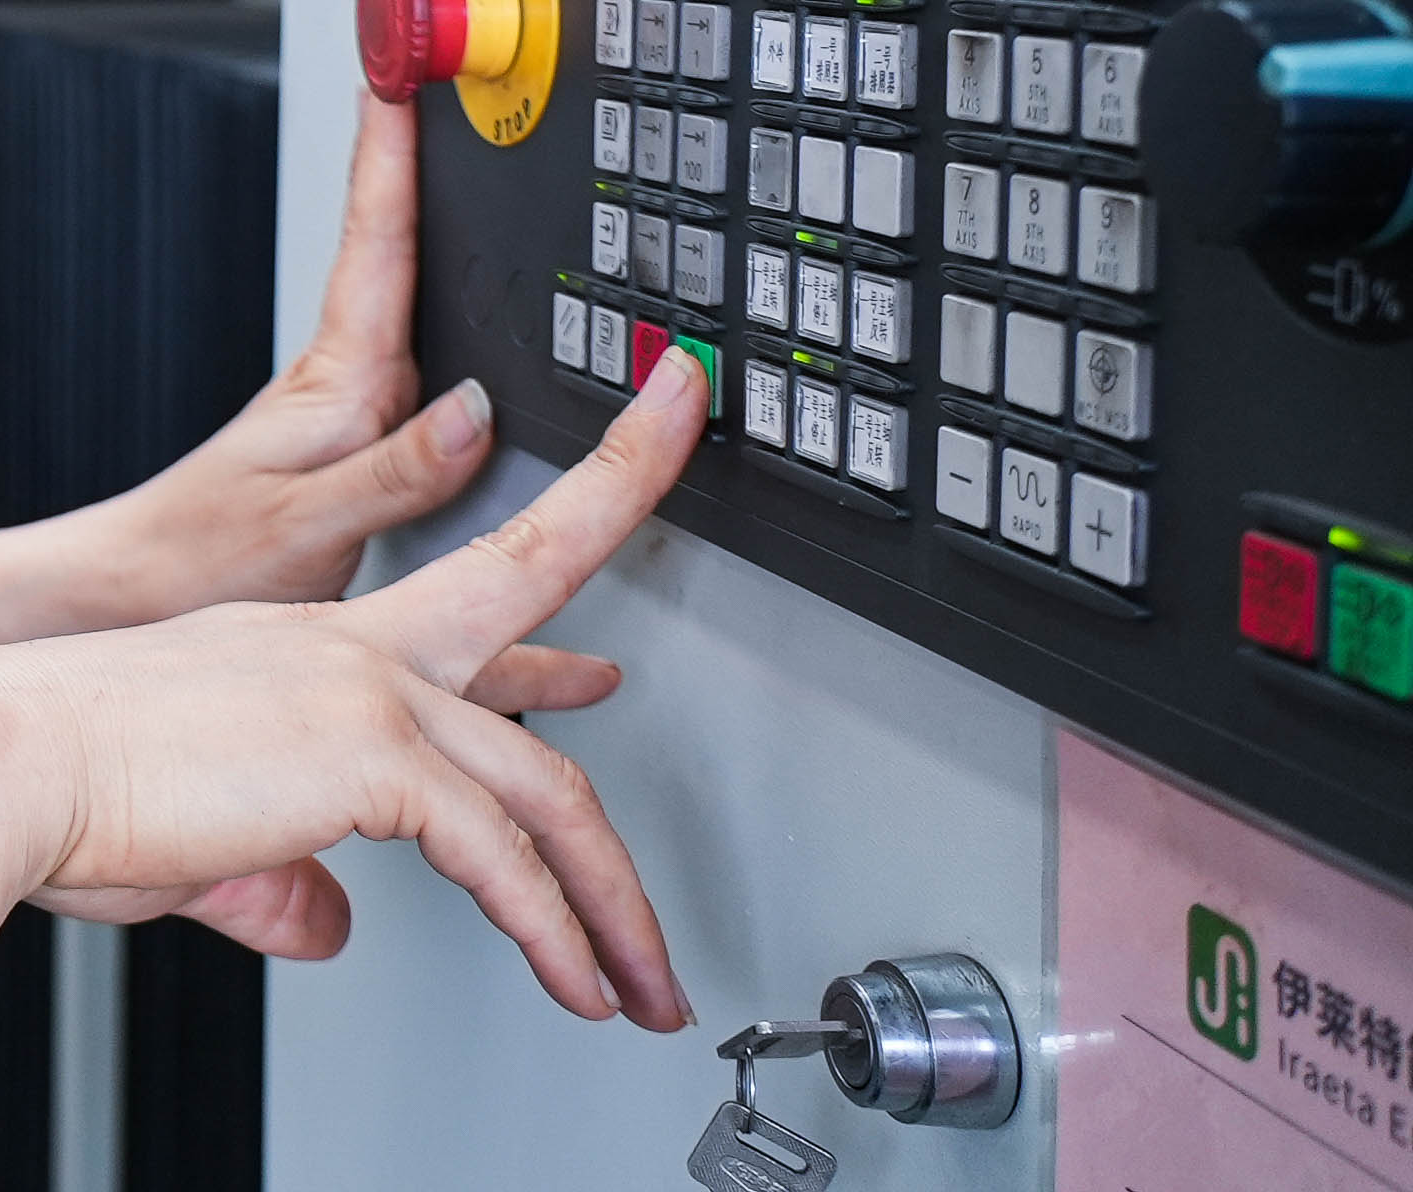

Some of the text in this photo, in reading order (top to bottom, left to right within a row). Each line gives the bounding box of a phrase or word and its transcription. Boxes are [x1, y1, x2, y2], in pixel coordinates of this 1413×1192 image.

[963, 38, 976, 64] 4
[1031, 48, 1043, 75] 5
[1103, 57, 1117, 84] 6
[958, 94, 982, 115] AXIS
[492, 97, 532, 142] STOP
[684, 159, 703, 183] 100
[961, 175, 972, 201] 7
[1028, 188, 1040, 216] 8
[1100, 200, 1113, 229] 9
[957, 209, 975, 228] 7TH
[955, 228, 977, 249] AXIS
[1012, 514, 1042, 542] RAPID
[1273, 958, 1413, 1093] 伊莱特
[1278, 1036, 1413, 1152] Iraeta E
